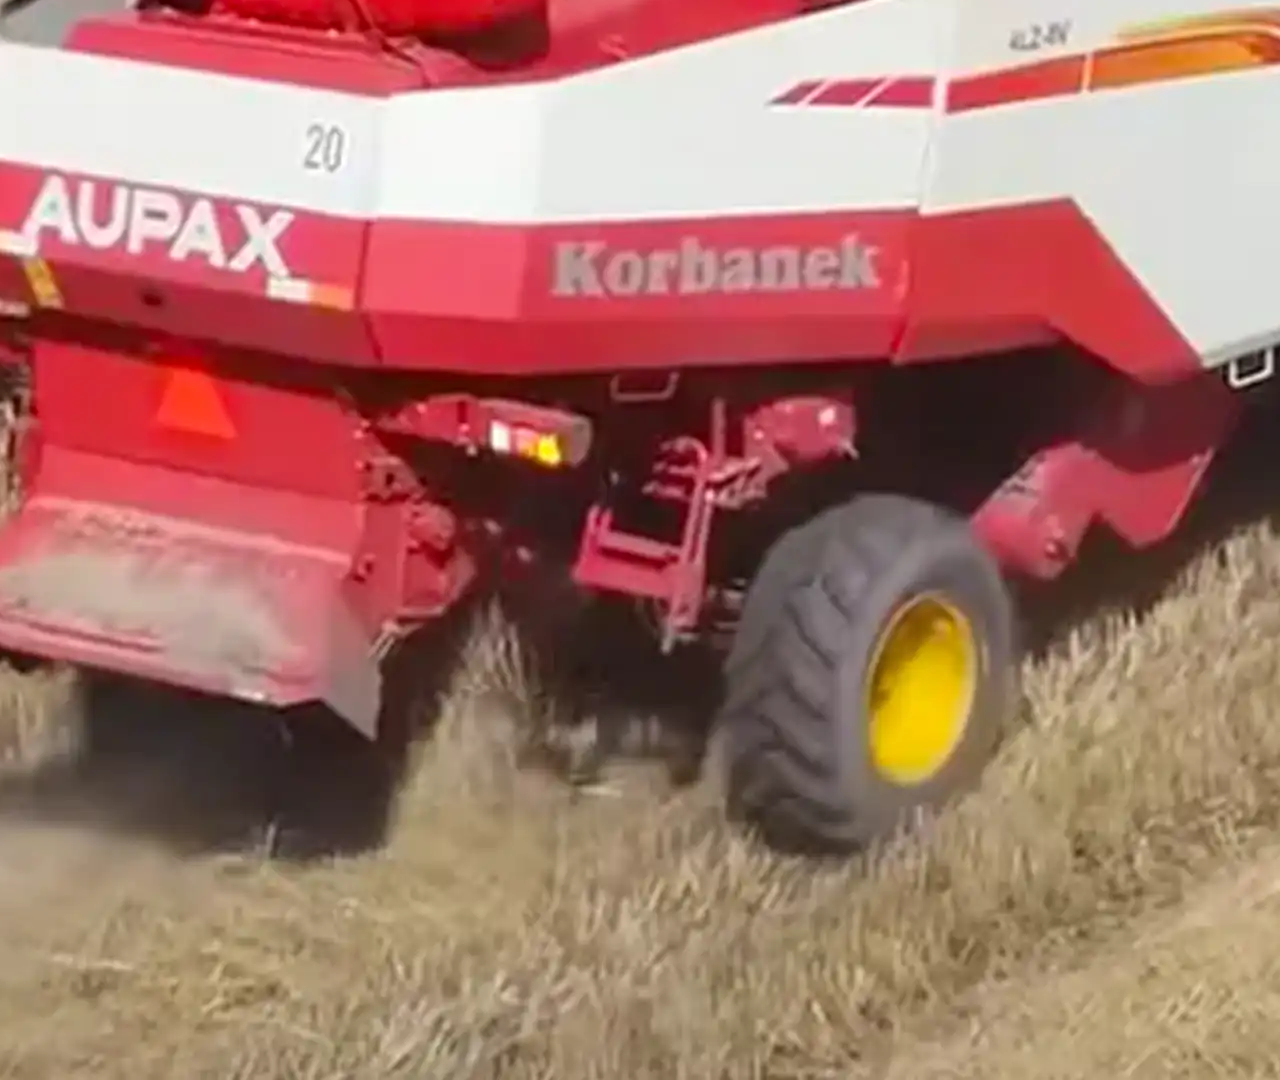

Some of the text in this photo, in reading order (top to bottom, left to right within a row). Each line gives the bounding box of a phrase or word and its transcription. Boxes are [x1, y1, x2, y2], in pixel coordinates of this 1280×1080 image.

[304, 124, 344, 173] 20
[20, 175, 295, 276] AUPAX
[550, 232, 880, 298] Korbanek
